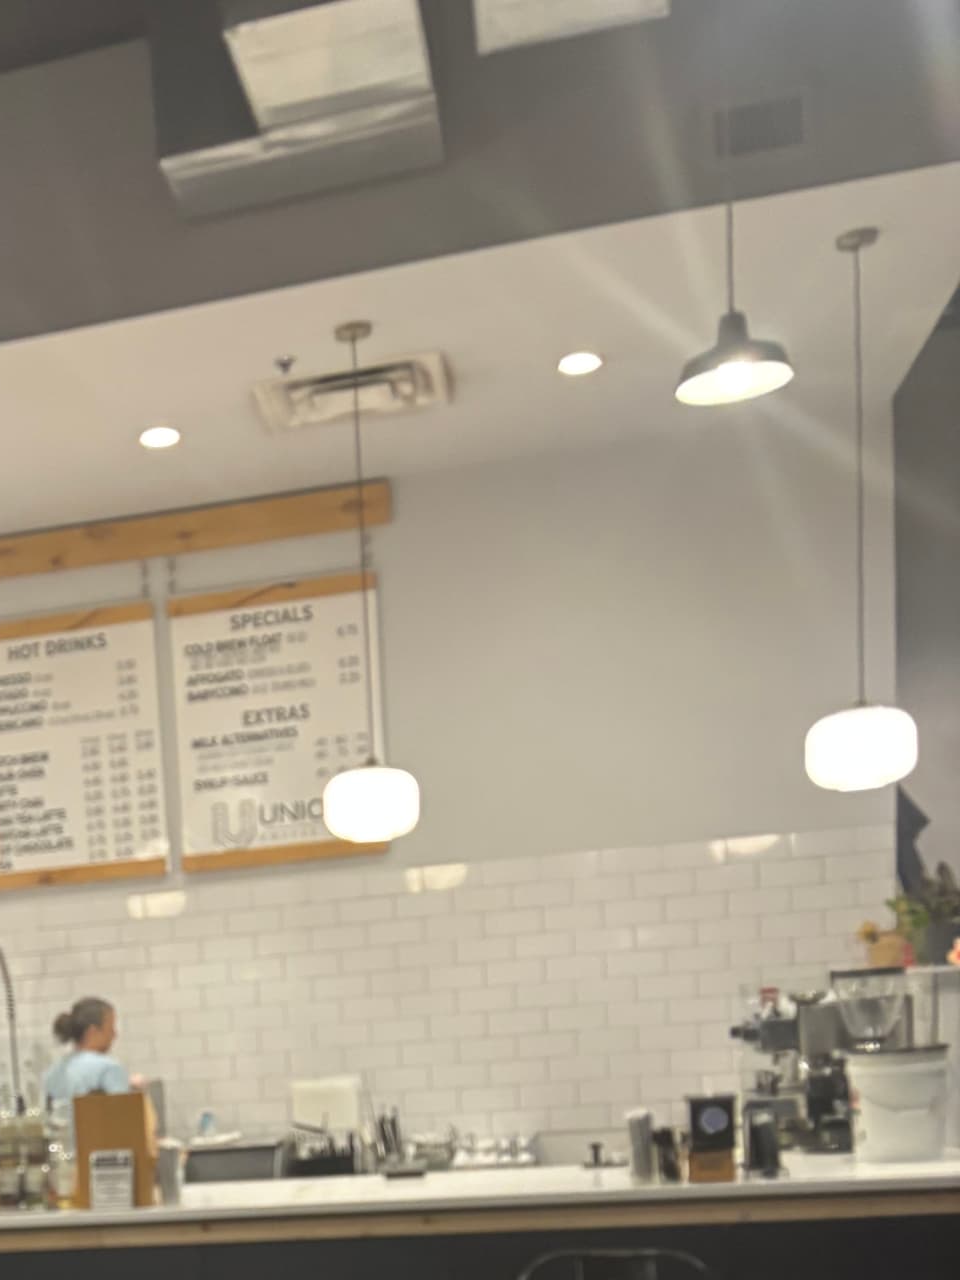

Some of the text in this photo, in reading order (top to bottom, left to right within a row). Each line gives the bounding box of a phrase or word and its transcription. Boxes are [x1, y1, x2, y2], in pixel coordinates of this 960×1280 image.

[230, 605, 313, 630] SPECIALS
[7, 632, 107, 661] HOT DRINKS
[184, 642, 214, 656] COLD
[216, 639, 247, 652] BREW
[249, 632, 283, 647] FLOAT
[242, 704, 310, 726] EXTRAS
